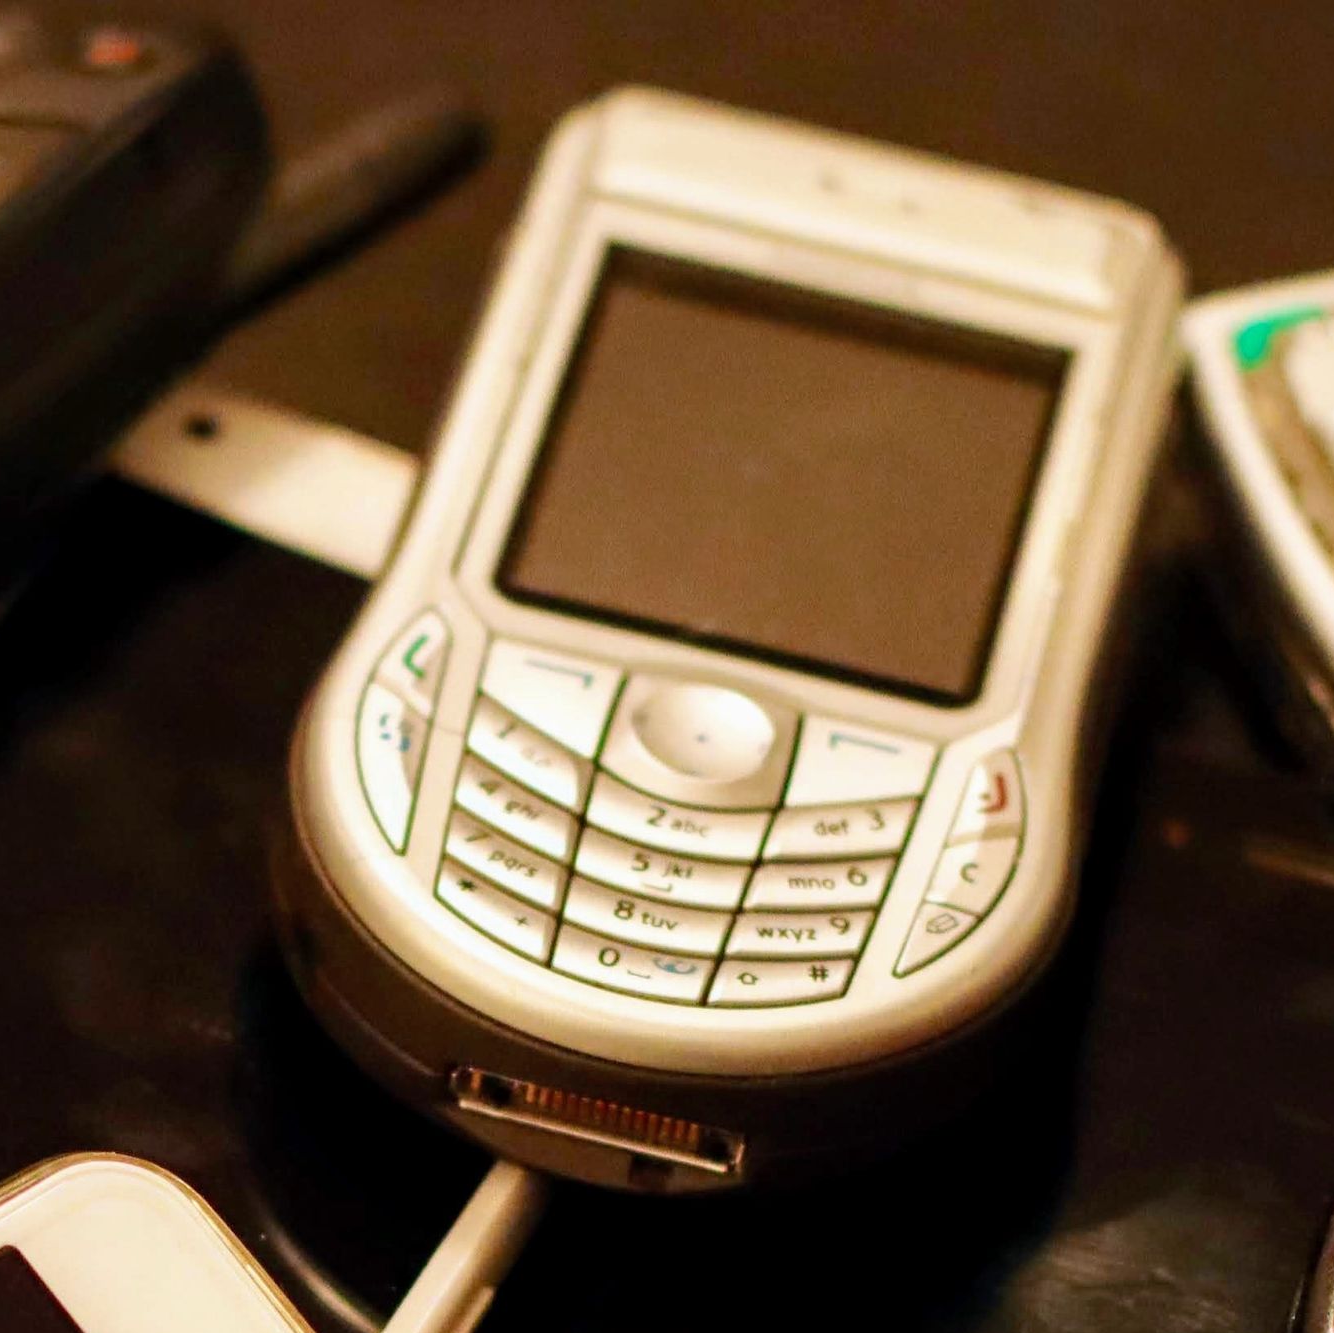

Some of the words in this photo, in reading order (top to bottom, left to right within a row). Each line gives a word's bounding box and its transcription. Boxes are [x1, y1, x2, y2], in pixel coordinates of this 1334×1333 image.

[646, 803, 668, 828] 2
[670, 817, 713, 839] abc
[869, 807, 886, 832] 3
[630, 851, 651, 874] 5
[788, 874, 836, 891] mno
[846, 865, 868, 888] 6
[613, 899, 637, 921] 8
[641, 910, 680, 932] tuv
[756, 924, 817, 945] wxyz
[829, 914, 851, 935] 9
